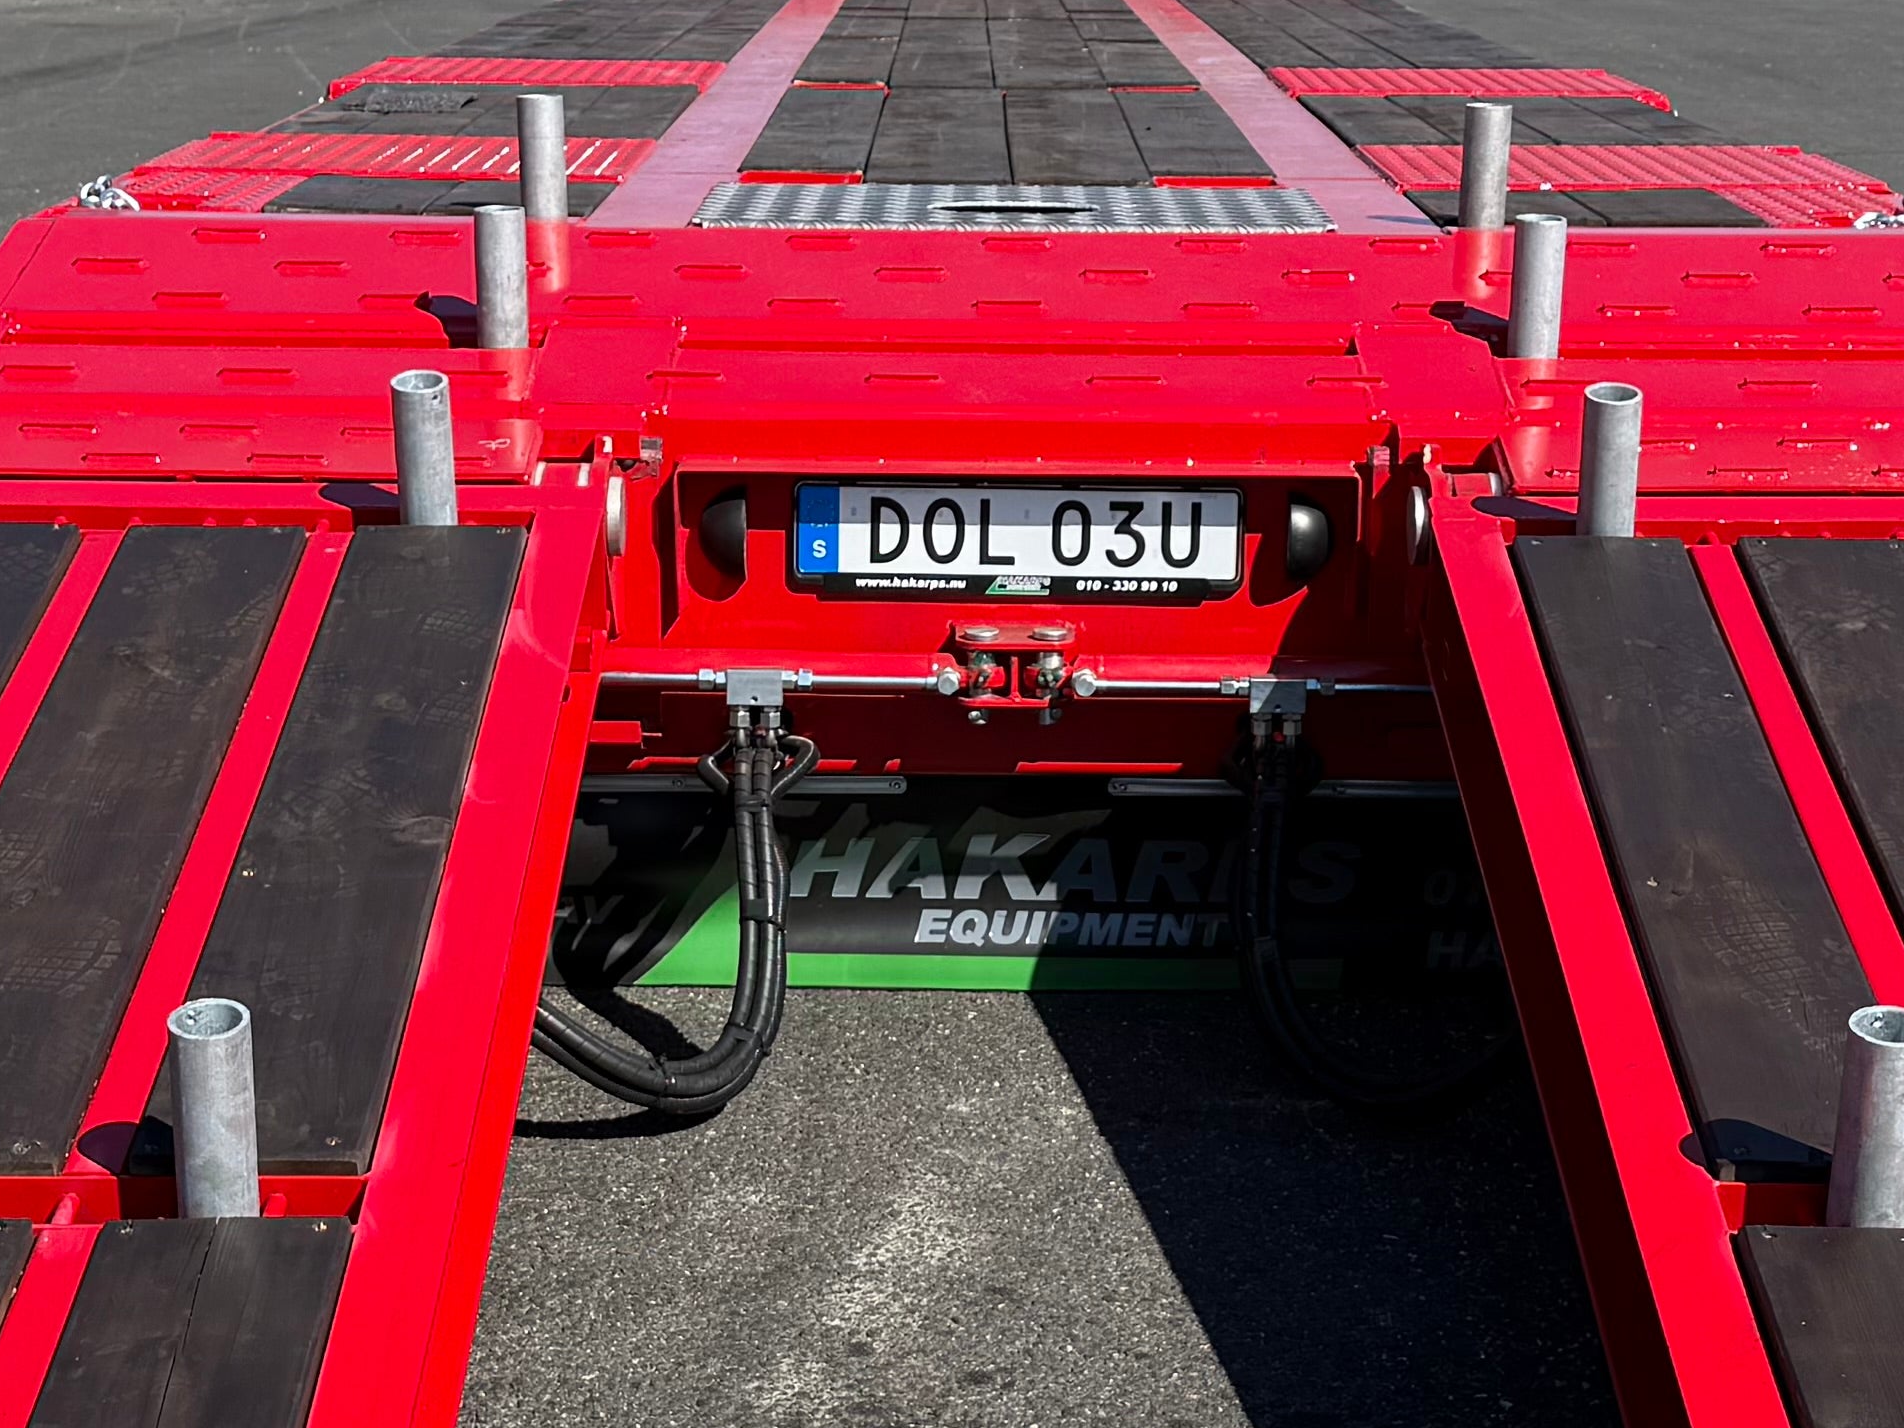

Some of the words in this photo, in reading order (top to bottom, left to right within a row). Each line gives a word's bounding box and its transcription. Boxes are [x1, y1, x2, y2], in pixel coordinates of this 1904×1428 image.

[869, 496, 1016, 567] DOL
[1051, 499, 1203, 569] 03U
[812, 539, 827, 559] S
[1076, 579, 1102, 591] 010
[1112, 580, 1138, 592] 330
[914, 908, 1230, 948] EQUIPMENT
